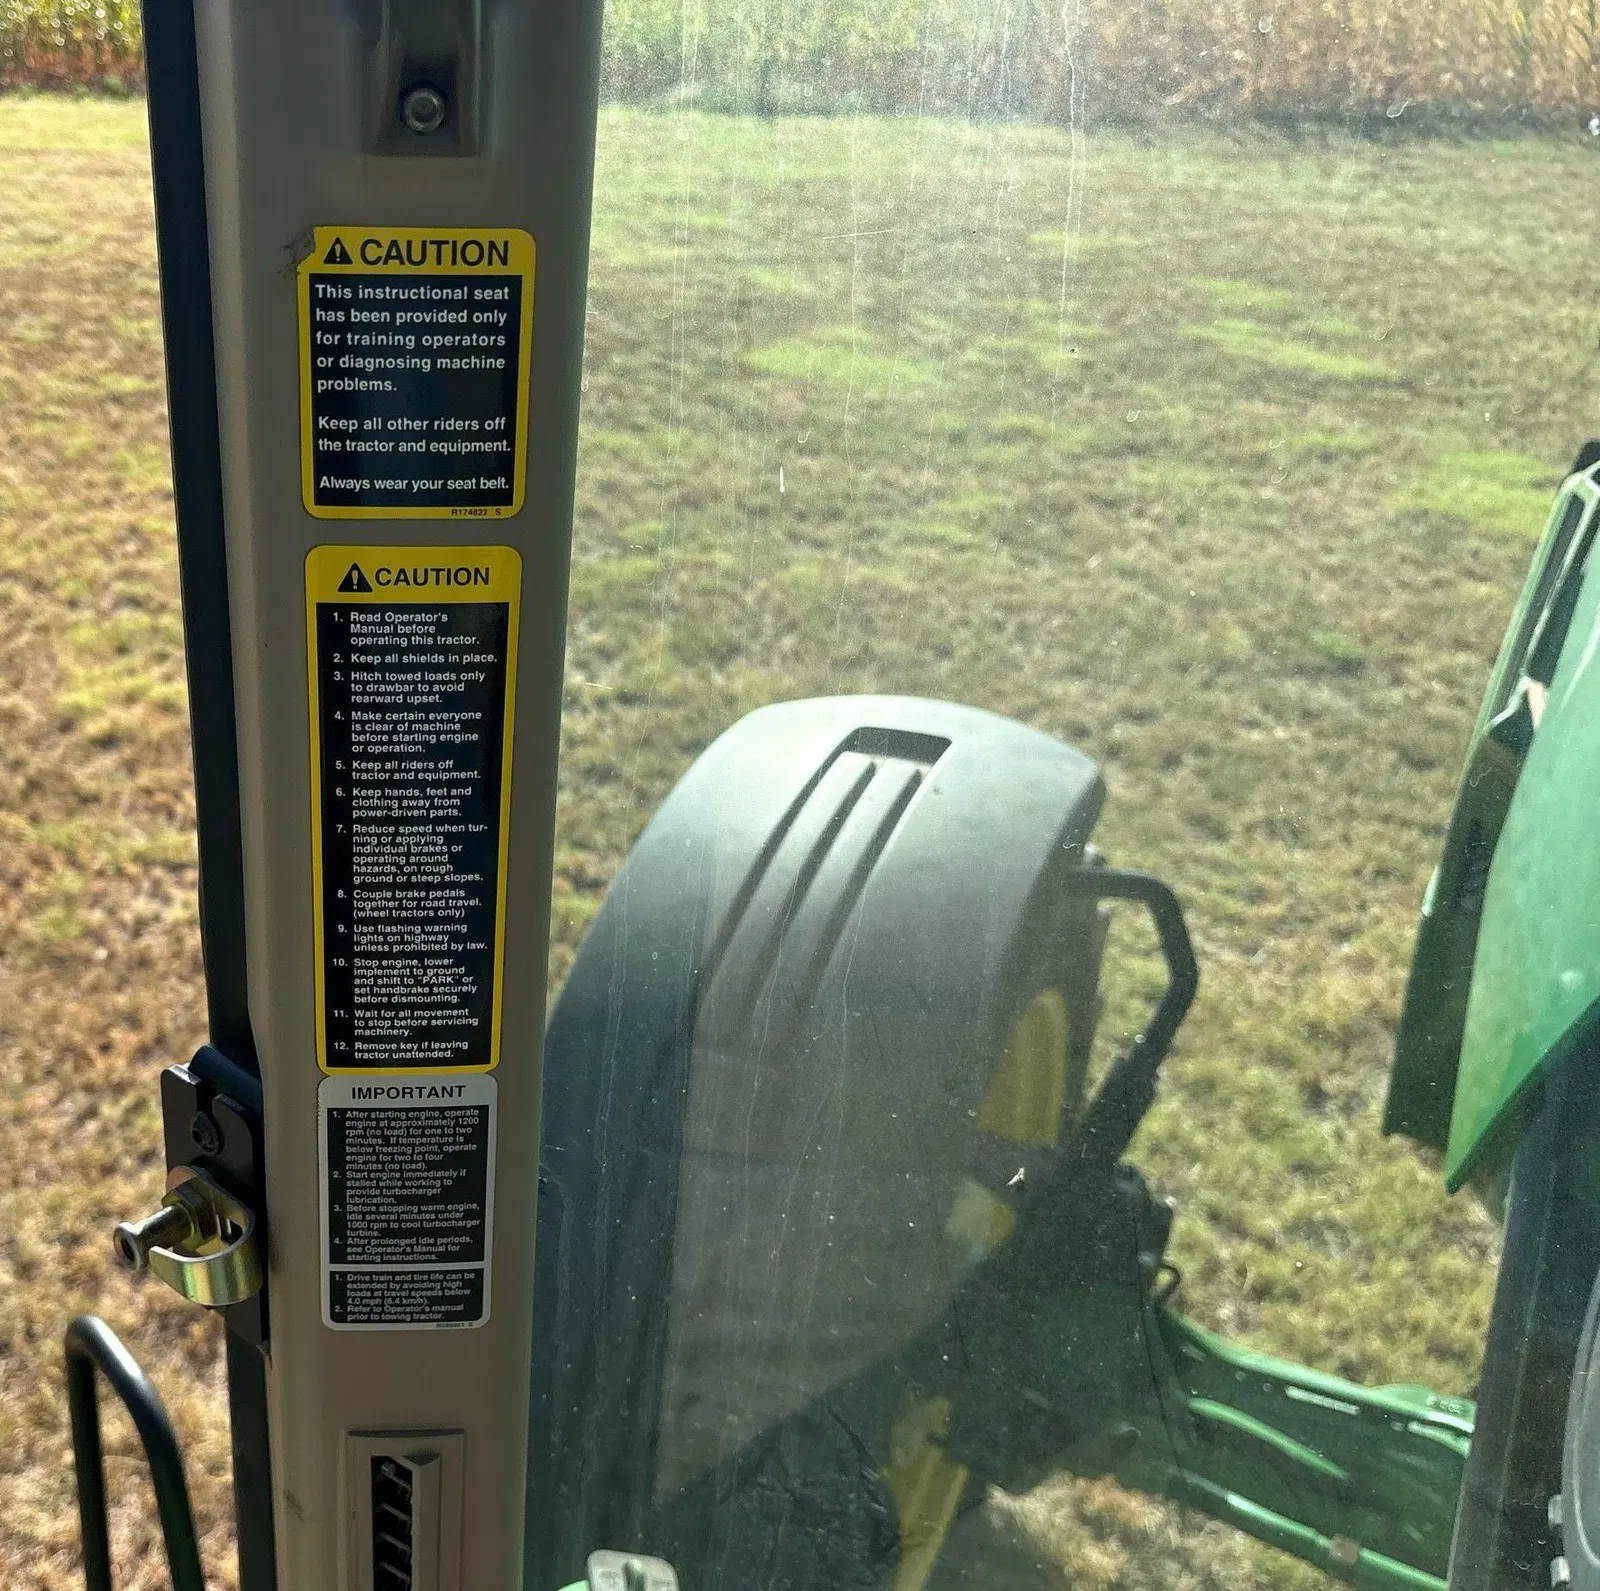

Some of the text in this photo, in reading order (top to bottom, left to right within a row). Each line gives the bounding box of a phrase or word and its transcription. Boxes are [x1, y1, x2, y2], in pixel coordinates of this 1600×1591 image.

[360, 239, 509, 265] CAUTION
[315, 284, 509, 299] This instructional seat
[316, 308, 507, 326] has been provided only
[316, 331, 505, 349] for training operators
[316, 354, 505, 372] or diagnosing machine
[317, 377, 397, 395] problems.
[318, 415, 505, 433] Keep all other riders off
[318, 437, 510, 455] the tractor and equipment.
[319, 475, 509, 493] Always wear your seat belt.
[374, 568, 489, 585] CAUTION
[333, 612, 448, 624] 1. Read Operator's
[350, 623, 436, 633] Manual before
[350, 634, 479, 647] operating this tractor.
[333, 652, 497, 665] 2. Keep all shields in place.
[333, 671, 485, 683] 3. Hitch towed loads only
[350, 682, 465, 692] to drawbar to avoid
[351, 693, 442, 705] rearward upset.
[334, 711, 482, 722] 4. Make certain everyone
[351, 722, 461, 731] is clear of machine
[351, 732, 478, 743] before starting engine
[367, 743, 425, 754] operation.
[335, 760, 454, 771] 5. Keep all riders off
[351, 770, 481, 781] tractor and equipment.
[335, 787, 472, 798] 6. Keep hands, feet and
[352, 797, 460, 809] clothing away from
[352, 807, 461, 819] power-driven parts.
[337, 824, 488, 835] 7. Reduce speed when tur-
[333, 958, 454, 968] 10. Stop engine, lower
[354, 966, 465, 977] implement to ground
[353, 976, 374, 985] and
[376, 976, 400, 984] shift
[403, 976, 414, 984] to
[417, 975, 458, 984] "PARK"
[354, 984, 477, 995] set handbrake securely
[354, 994, 460, 1004] before dismounting.
[334, 1008, 468, 1018] 11. Wait for all movement
[354, 1017, 478, 1028] to stop before servicing
[354, 1028, 412, 1038] machinery.
[334, 1041, 468, 1051] 12. Remove key if leaving
[354, 1050, 453, 1059] tractor unattended.
[351, 1085, 466, 1100] IMPORTANT
[345, 1110, 368, 1118] After
[370, 1110, 406, 1120] starting
[408, 1109, 442, 1119] engine,
[444, 1108, 479, 1118] operate
[345, 1119, 376, 1129] engine
[390, 1118, 455, 1128] approximately
[458, 1117, 479, 1125] 1200
[346, 1187, 380, 1197] provide
[346, 1204, 376, 1212] Before
[378, 1204, 418, 1213] stopping
[446, 1203, 480, 1212] engine,
[346, 1313, 368, 1322] prior
[381, 1312, 411, 1322] towing
[412, 1312, 444, 1320] tractor.
